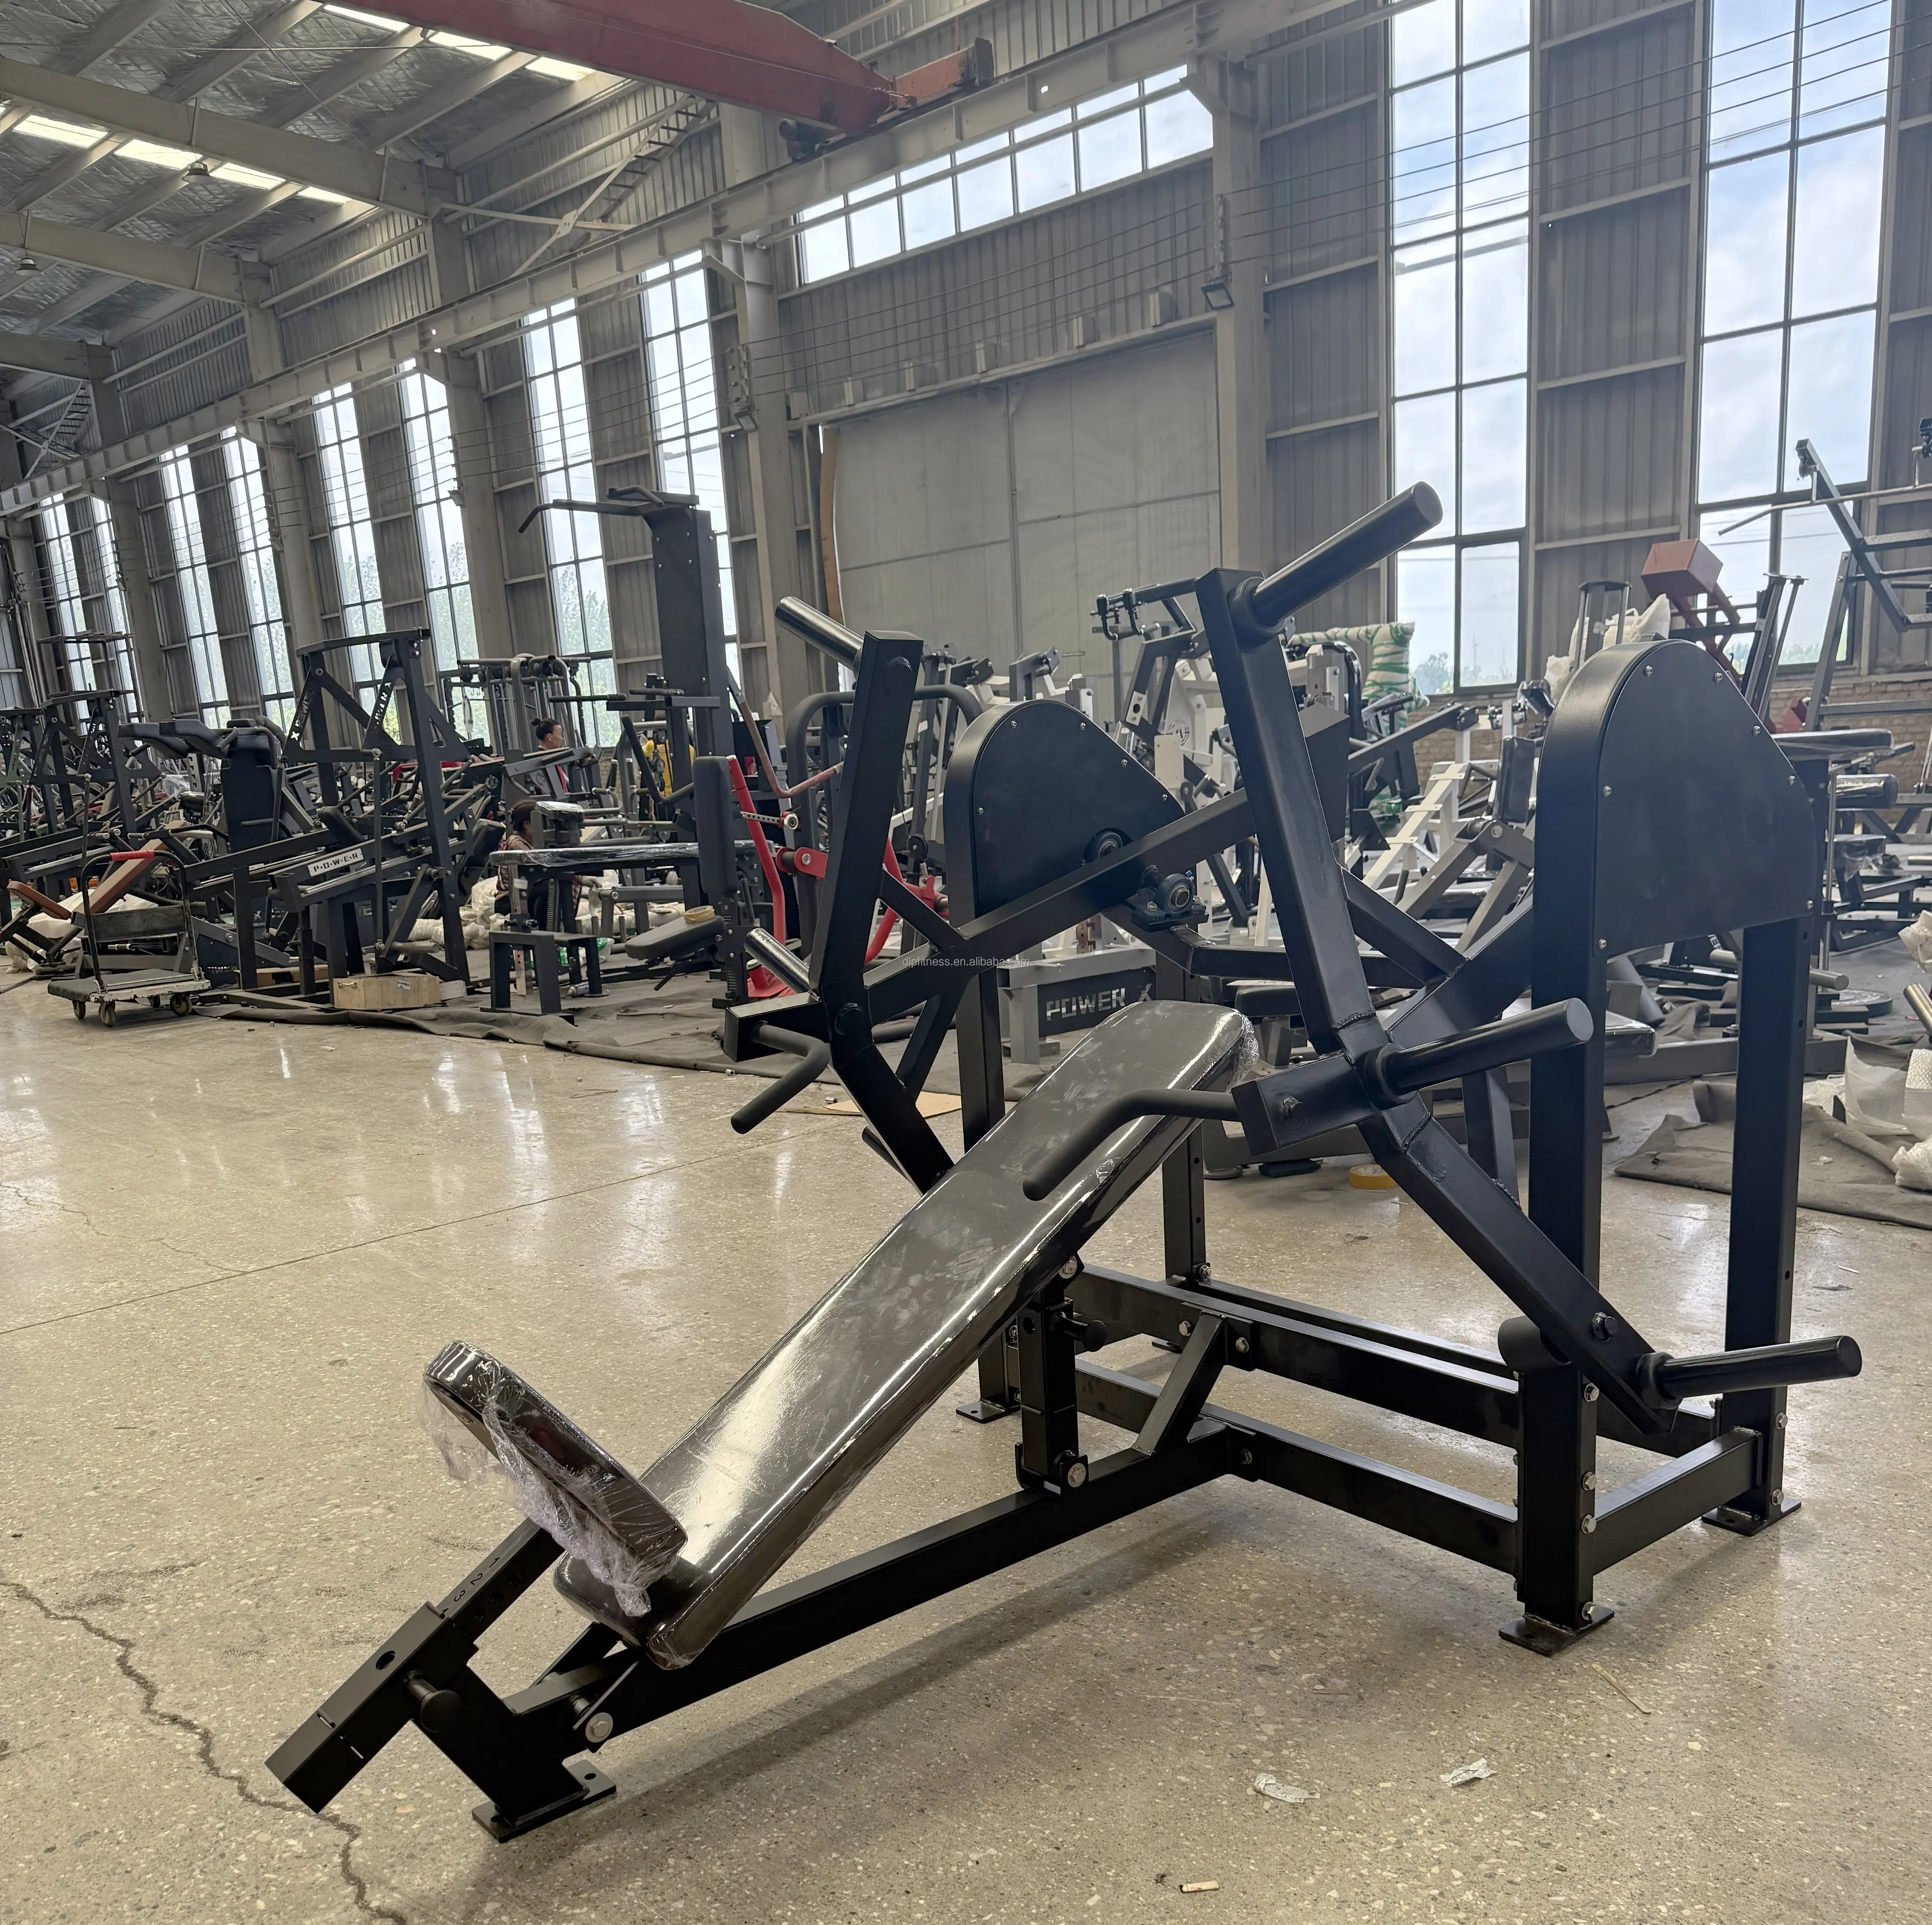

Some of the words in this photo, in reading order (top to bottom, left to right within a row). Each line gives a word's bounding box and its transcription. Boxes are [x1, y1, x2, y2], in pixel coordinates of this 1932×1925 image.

[1046, 987, 1126, 1021] POWER
[1137, 983, 1152, 1002] X
[470, 1573, 483, 1585] 2
[454, 1590, 465, 1602] 3
